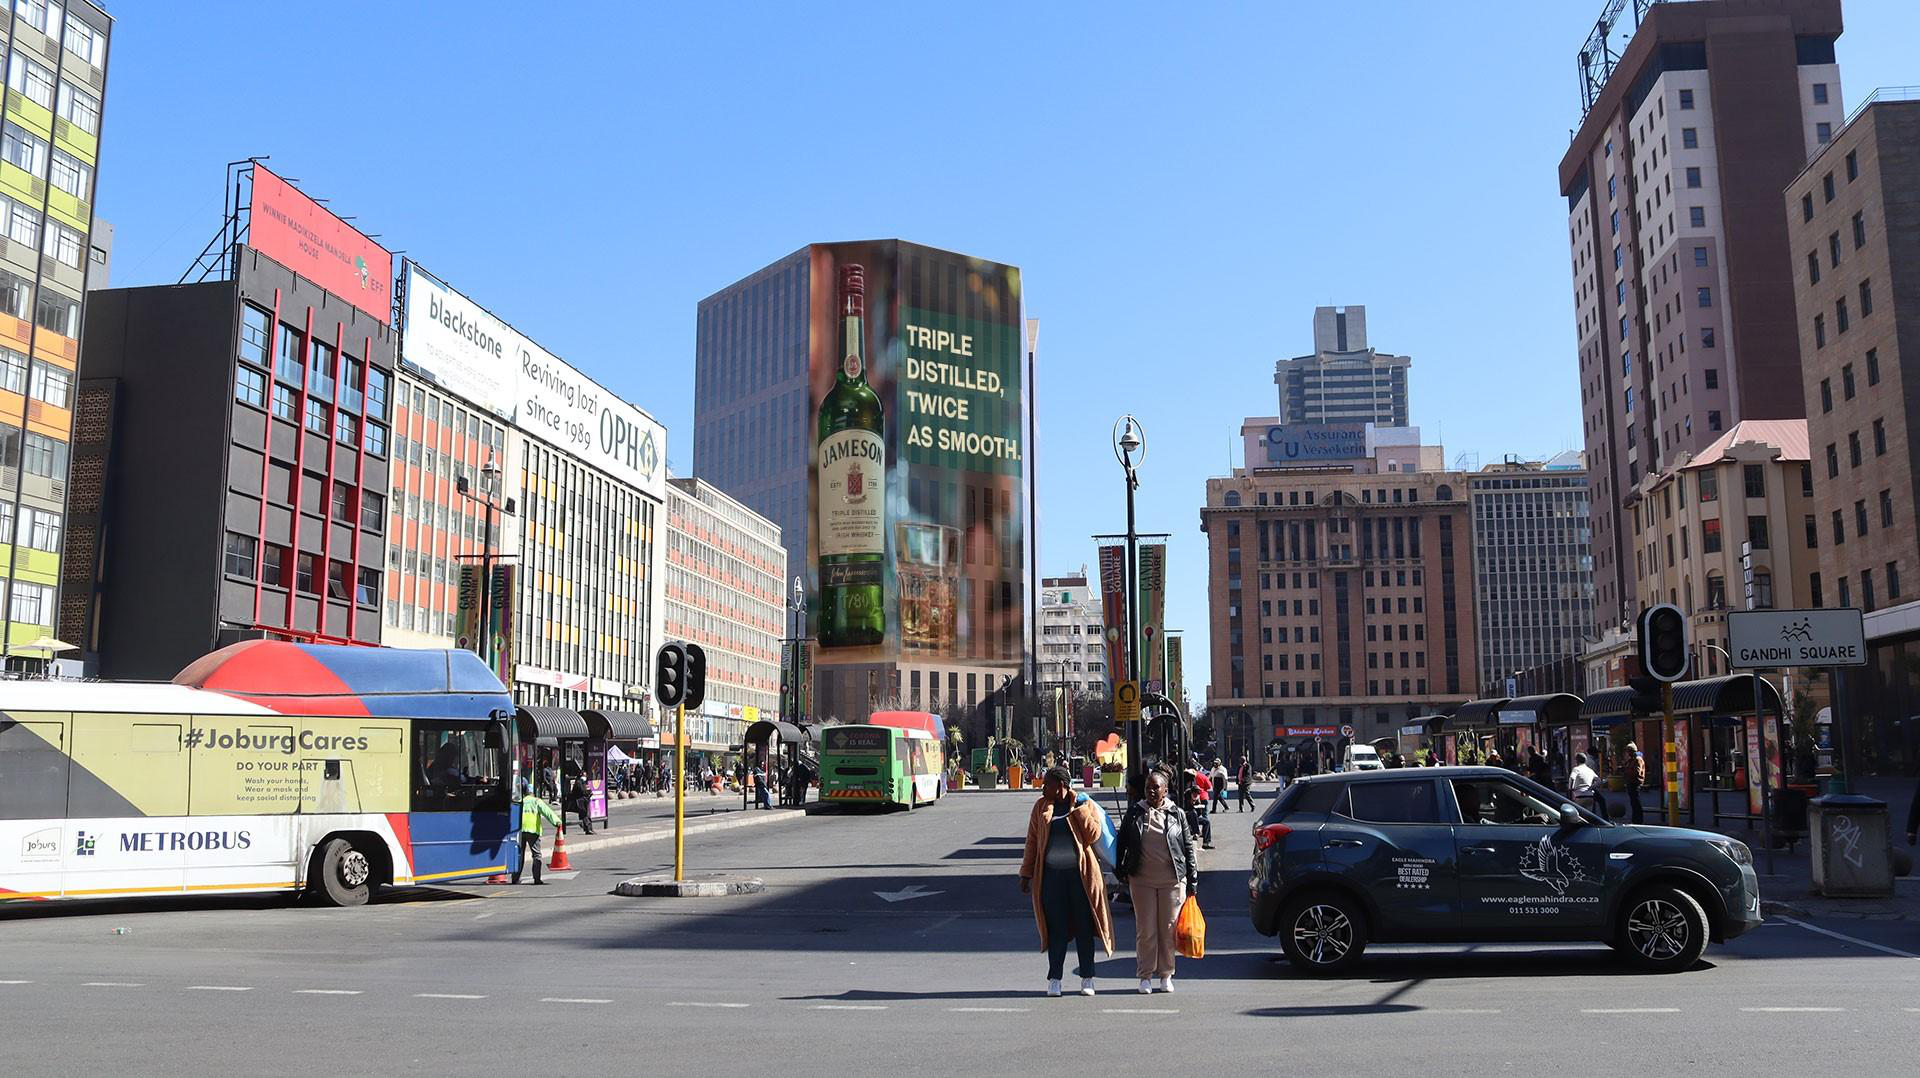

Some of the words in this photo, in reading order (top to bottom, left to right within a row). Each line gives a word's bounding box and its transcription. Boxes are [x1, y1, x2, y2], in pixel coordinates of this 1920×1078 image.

[262, 202, 287, 222] WINNIE
[298, 239, 319, 260] HOUSE
[370, 279, 384, 293] EFF
[429, 291, 503, 360] blackstone
[906, 324, 973, 357] TRIPLE
[522, 350, 575, 408] Reviving
[576, 384, 598, 417] Jozi
[906, 357, 1004, 398] DISTILLED,
[906, 390, 969, 420] TWICE
[526, 394, 561, 431] since
[564, 420, 591, 451] 1989
[1304, 430, 1365, 441] Assuranc
[600, 407, 639, 471] OPH
[822, 439, 883, 469] JAMESON
[907, 424, 933, 448] AS
[938, 428, 1022, 460] SMOOTH.
[1101, 546, 1114, 593] GANDHI
[1113, 555, 1121, 592] SQUARE
[1140, 545, 1153, 592] GANDHI
[1153, 552, 1161, 592] SQUARE
[460, 568, 473, 610] GANDHI
[493, 567, 504, 609] GANDHI
[1740, 647, 1791, 661] GANDHI
[1800, 645, 1857, 660] SQUARE
[183, 727, 369, 754] #JoburgCares
[236, 762, 254, 771] DO
[258, 762, 289, 771] YOUR
[292, 762, 319, 771] PART
[245, 777, 266, 785] Wash
[236, 794, 255, 803] keep
[279, 794, 317, 803] distancing
[119, 830, 252, 852] METROBUS
[1397, 867, 1411, 876] BEST
[1411, 868, 1430, 876] RATED
[1399, 875, 1428, 883] DEALERSHIP
[1481, 895, 1599, 904] www.eaglemahindra.co.za
